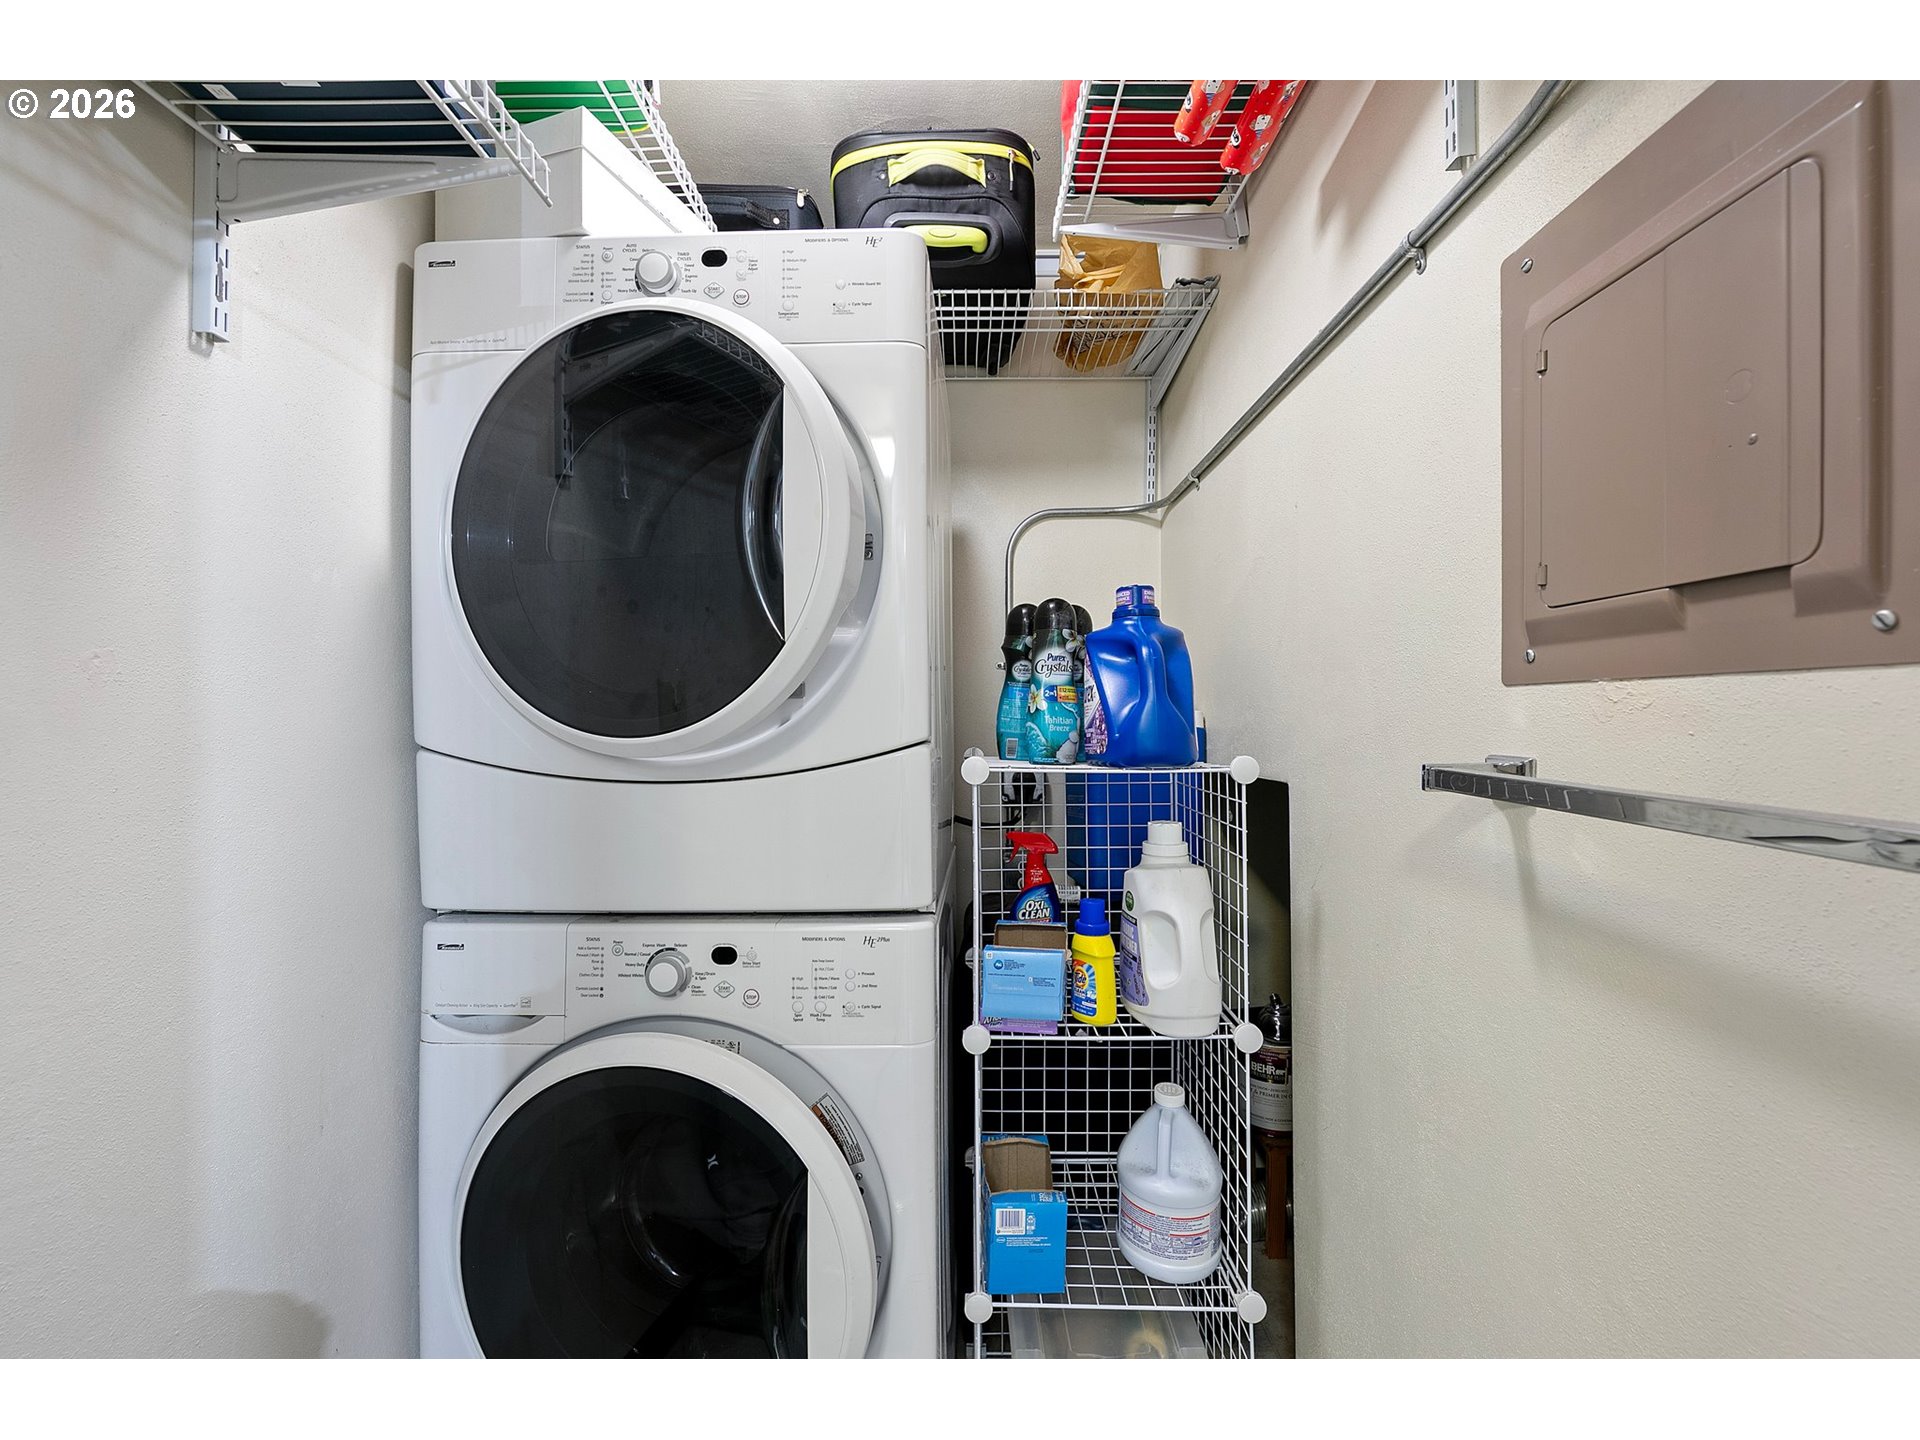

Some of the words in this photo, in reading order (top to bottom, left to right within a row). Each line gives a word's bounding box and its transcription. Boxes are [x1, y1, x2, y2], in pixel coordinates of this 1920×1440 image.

[1047, 653, 1066, 662] Purex
[1035, 659, 1073, 678] Crystals
[1044, 715, 1073, 724] Tahitian
[1025, 900, 1044, 911] OXI
[1018, 908, 1050, 920] CLEAN
[1251, 1061, 1276, 1075] BEHR
